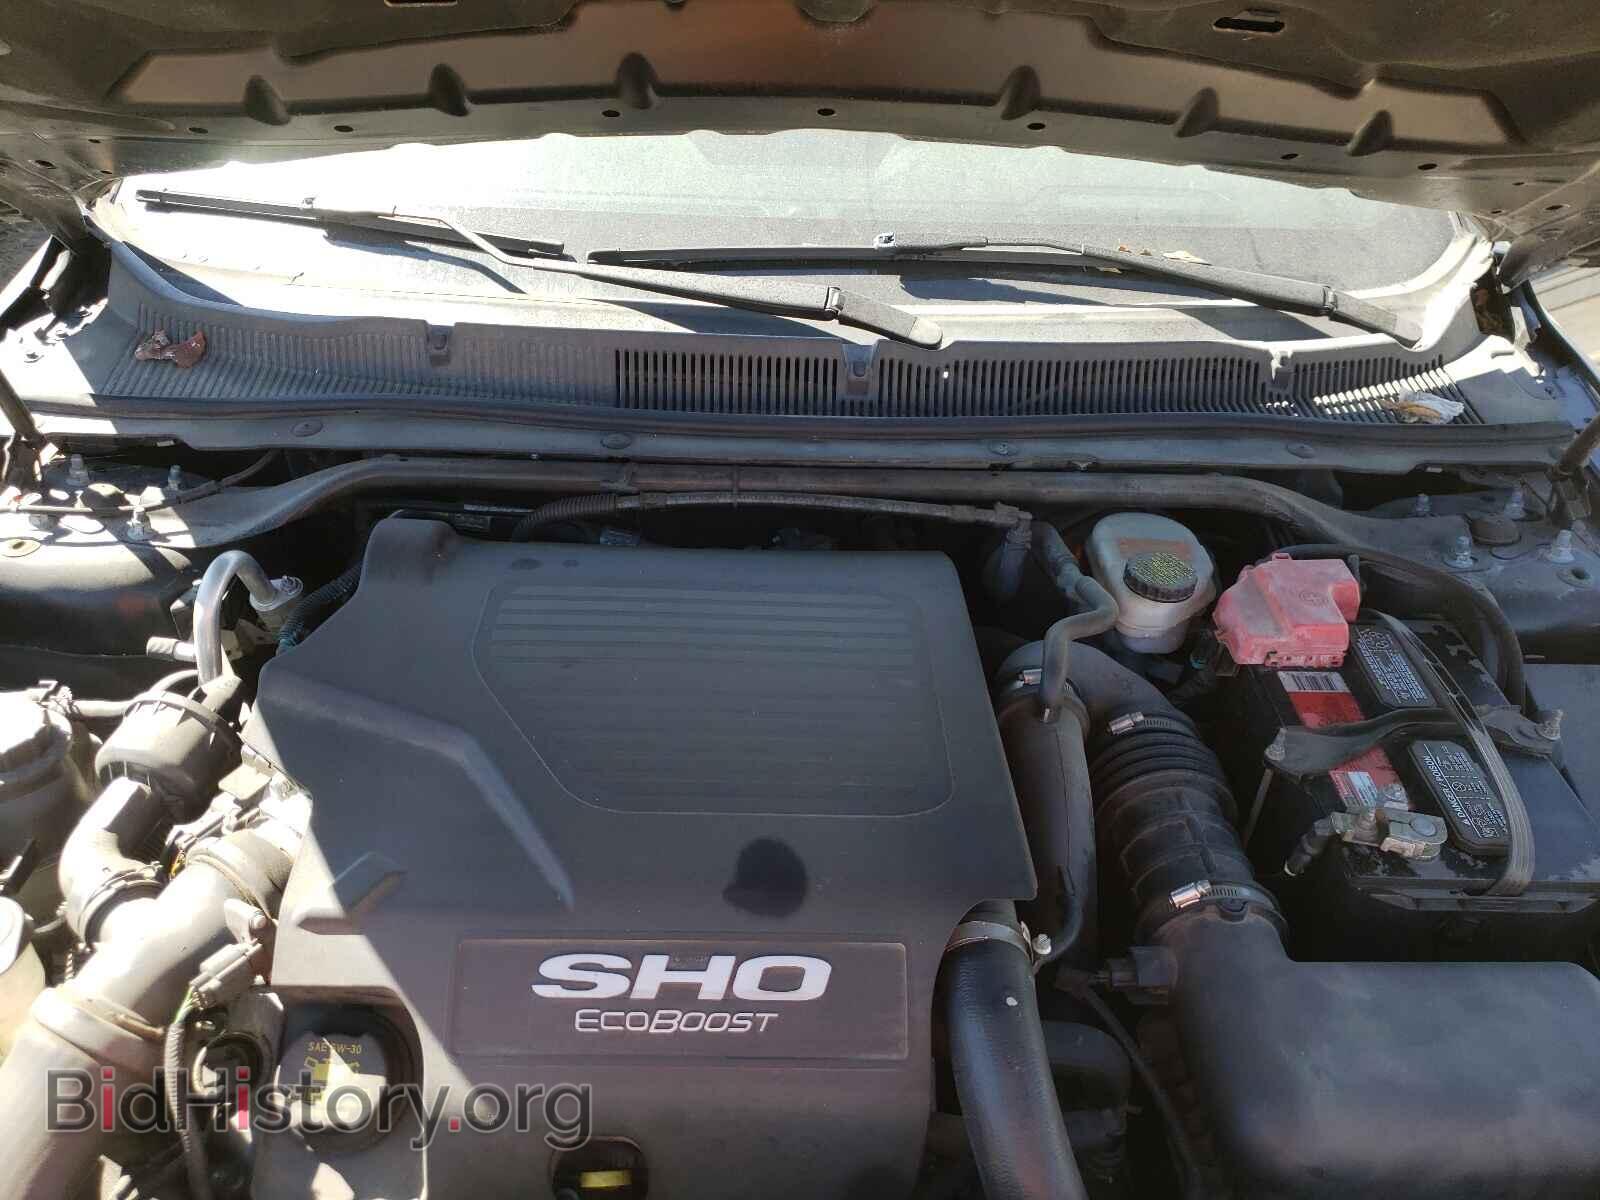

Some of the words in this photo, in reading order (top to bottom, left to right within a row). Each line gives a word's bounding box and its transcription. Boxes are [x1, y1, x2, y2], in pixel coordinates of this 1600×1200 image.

[1423, 755, 1444, 783] POISON
[531, 953, 833, 1001] SHO
[307, 1041, 328, 1053] SAE
